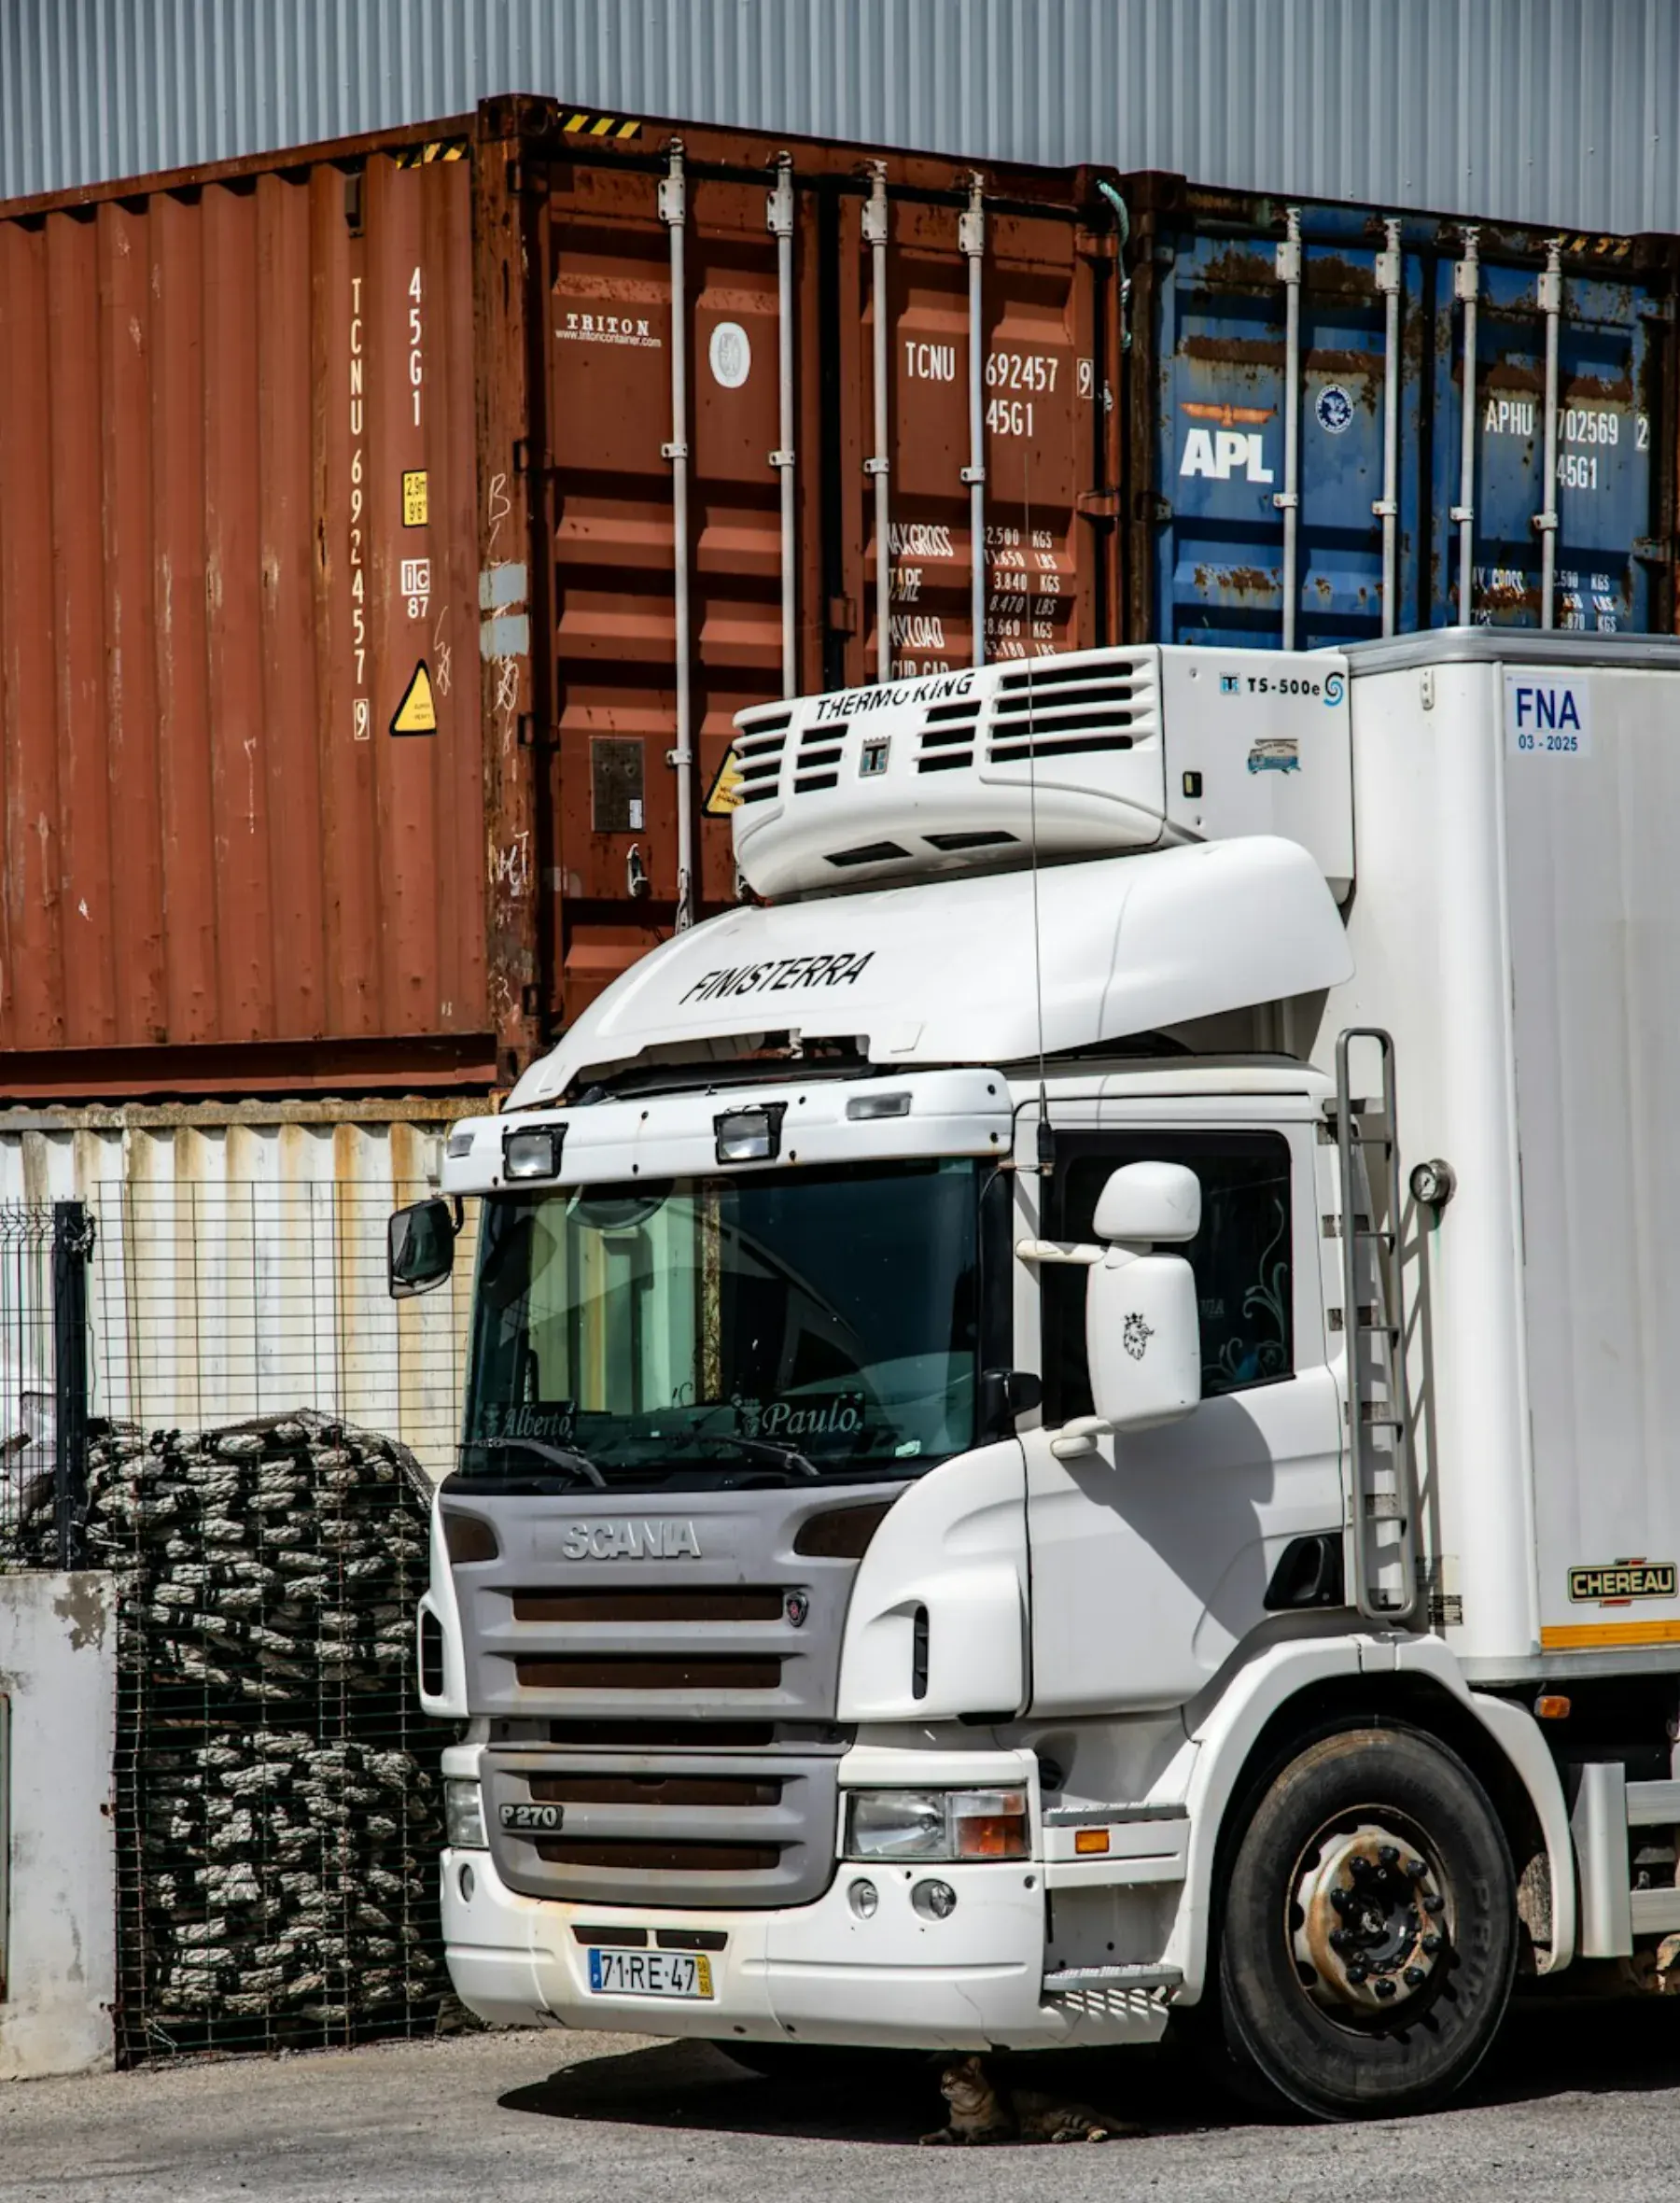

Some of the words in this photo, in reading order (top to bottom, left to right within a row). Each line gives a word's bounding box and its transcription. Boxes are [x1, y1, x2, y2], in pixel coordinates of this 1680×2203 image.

[567, 313, 650, 336] TRITON
[350, 278, 363, 436] TCNU
[408, 267, 423, 426] 45G1
[905, 342, 955, 382] TCNU
[986, 353, 1058, 392] 692457
[1079, 361, 1091, 395] 9
[986, 400, 1033, 437] 45G1
[1485, 400, 1533, 436] APHU
[1557, 408, 1618, 445] 702569
[1636, 417, 1648, 448] 2
[1180, 429, 1274, 484] APL
[1557, 455, 1598, 490] 45G1
[1032, 530, 1053, 549] KGS
[349, 448, 365, 684] 692457
[1034, 554, 1057, 569] LBS
[1040, 574, 1060, 593] KGS
[408, 596, 428, 618] 87
[1032, 622, 1053, 639] KGS
[912, 673, 975, 704] KING
[1248, 677, 1321, 696] TS-500e
[355, 701, 368, 737] 9
[1517, 688, 1580, 731] FNA
[1519, 734, 1534, 751] 03
[1547, 736, 1578, 752] 2025
[679, 950, 876, 1005] FINISTERRA
[500, 1404, 571, 1438] Alberto
[762, 1397, 858, 1437] Paulo
[562, 1520, 702, 1560] SCANIA
[1573, 1569, 1673, 1596] CHEREAU
